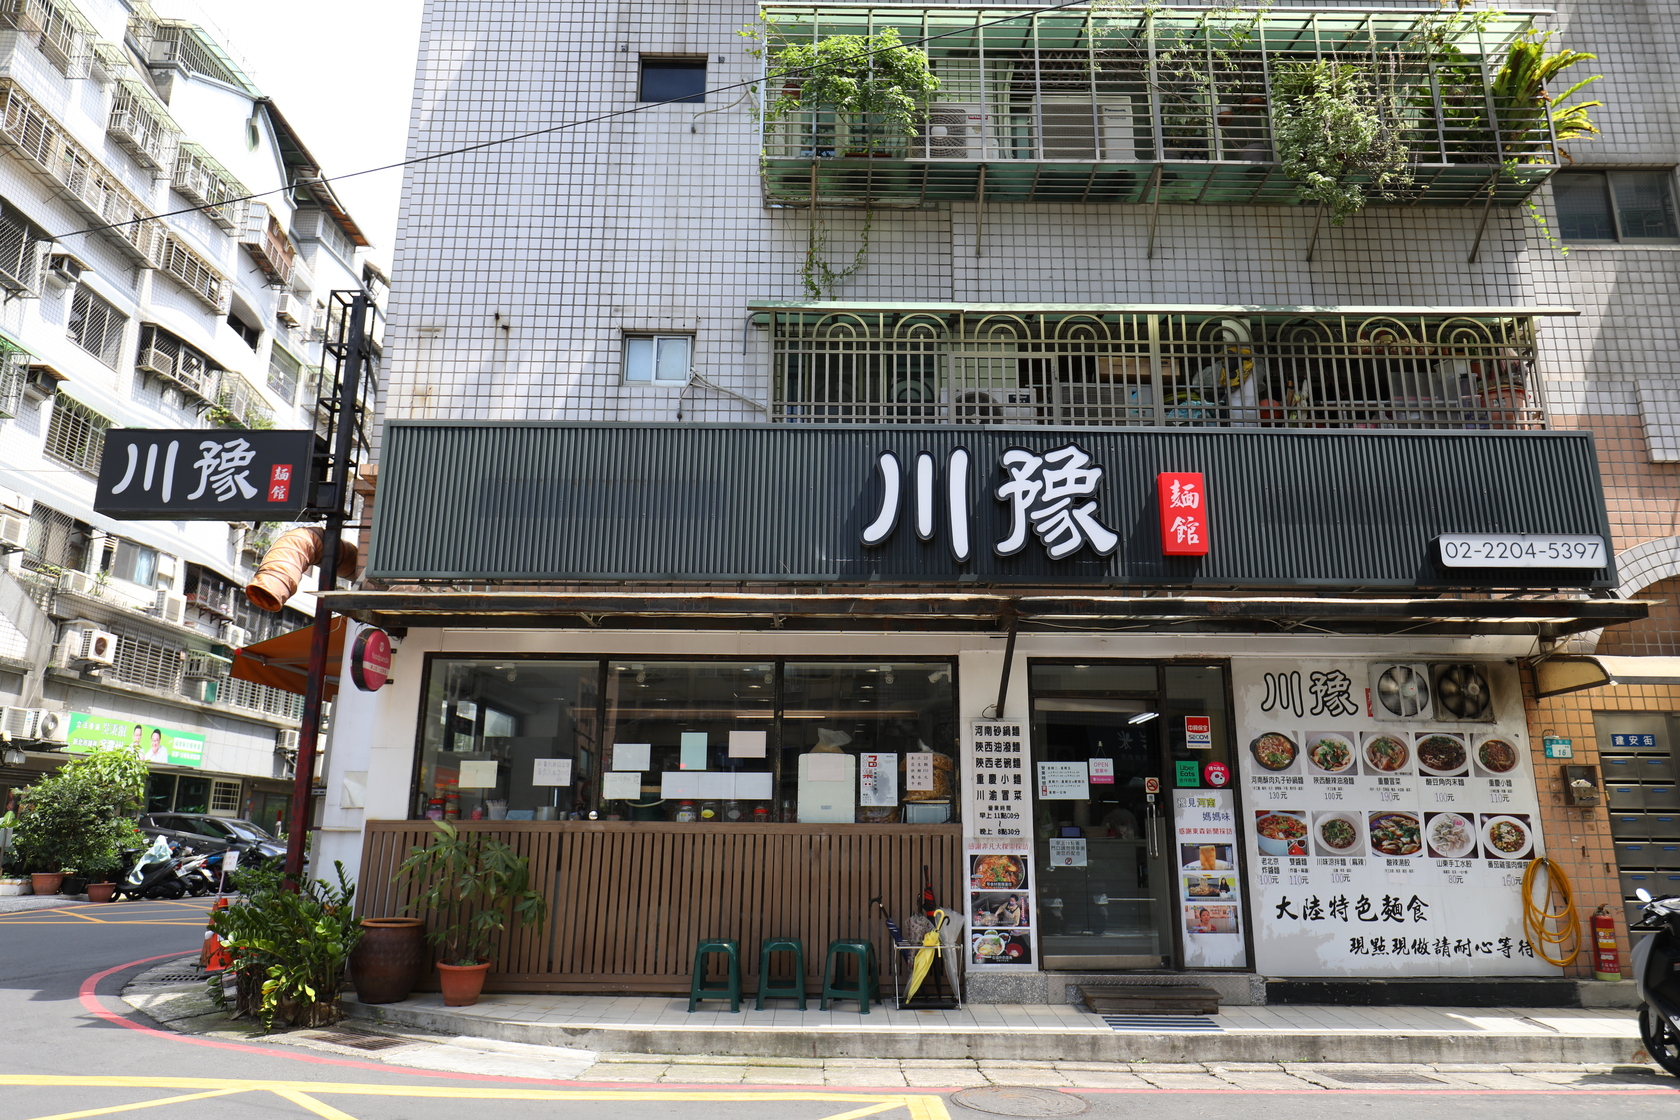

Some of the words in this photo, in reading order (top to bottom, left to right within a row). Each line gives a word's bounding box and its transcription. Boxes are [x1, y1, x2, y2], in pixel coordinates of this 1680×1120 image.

[111, 437, 258, 503] 川豫
[271, 466, 289, 501] 麵館
[862, 445, 1119, 559] 川豫
[1169, 479, 1200, 546] 麵館
[1445, 541, 1600, 560] 02-2204-5397
[1260, 669, 1359, 718] 川豫
[975, 725, 1020, 736] 河南砂鍋麵
[1614, 735, 1653, 746] 建安街
[1557, 749, 1567, 757] 16
[975, 757, 1022, 768] 陝西老碗麵
[976, 773, 1022, 785] 重慶小麵
[1378, 777, 1402, 786] 重慶冒菜
[1488, 779, 1512, 787] 重慶小麵
[976, 789, 1022, 801] 川渝冒菜
[1269, 791, 1288, 800] 130元
[1324, 791, 1343, 800] 100元
[1435, 793, 1455, 803] 100元
[1202, 812, 1231, 822] 媽媽味
[979, 828, 993, 836] 晚上
[997, 828, 1021, 836] 8點30分
[1261, 858, 1280, 866] 老北京
[1386, 858, 1411, 867] 酸辣湯餃
[1436, 859, 1473, 868] 山東手工水餃
[1260, 875, 1279, 885] 100元
[1289, 875, 1309, 885] 110元
[1331, 873, 1351, 883] 100元
[1276, 894, 1429, 923] 大陸特色麵食
[1349, 936, 1535, 959] 現點現做請耐心等待
